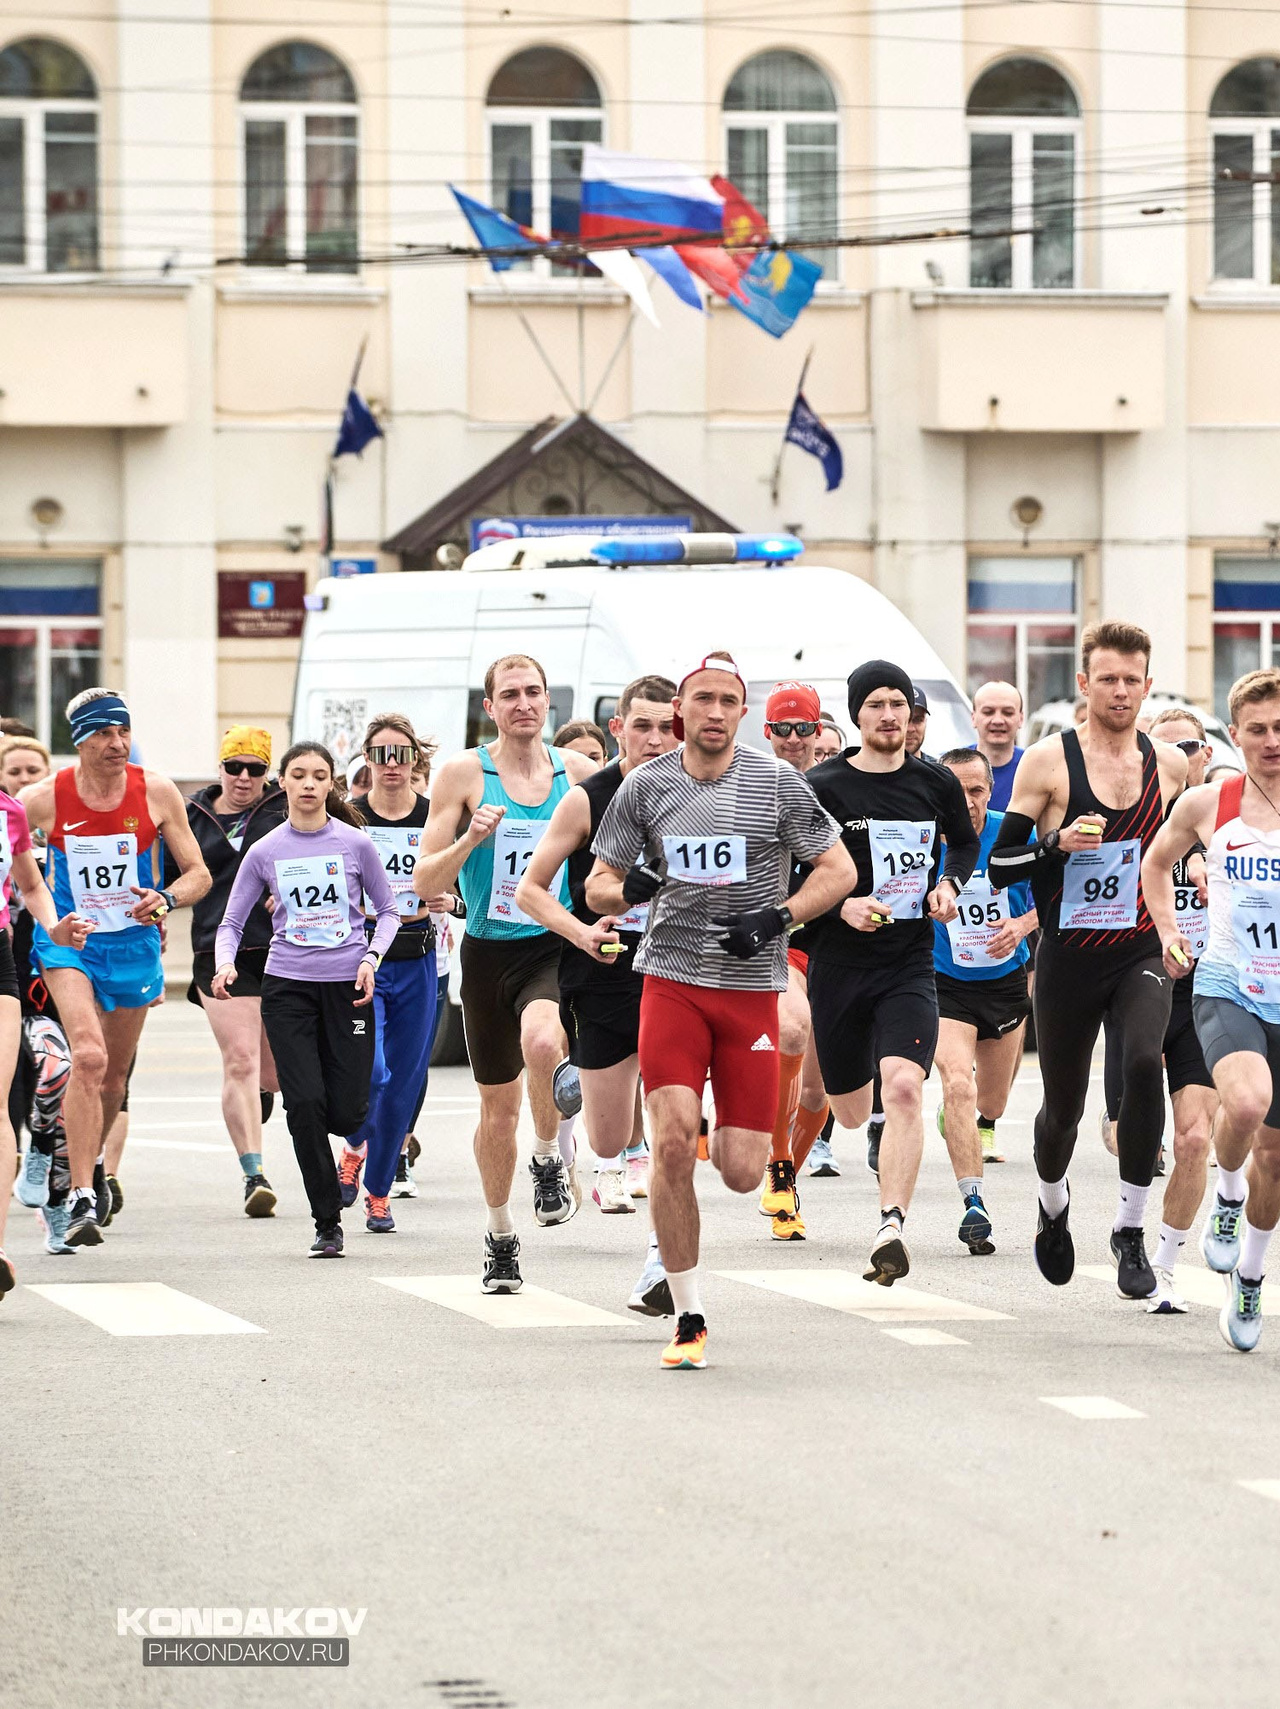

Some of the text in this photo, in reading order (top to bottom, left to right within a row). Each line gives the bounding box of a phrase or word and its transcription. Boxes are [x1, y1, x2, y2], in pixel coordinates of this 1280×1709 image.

[378, 853, 416, 875] 49
[676, 841, 732, 870] 116
[78, 864, 127, 889] 187
[1083, 875, 1119, 903] 98
[289, 883, 339, 908] 124
[1174, 889, 1204, 911] 88
[958, 902, 1001, 927] 195
[1251, 960, 1280, 968] КРАСНЫЙ
